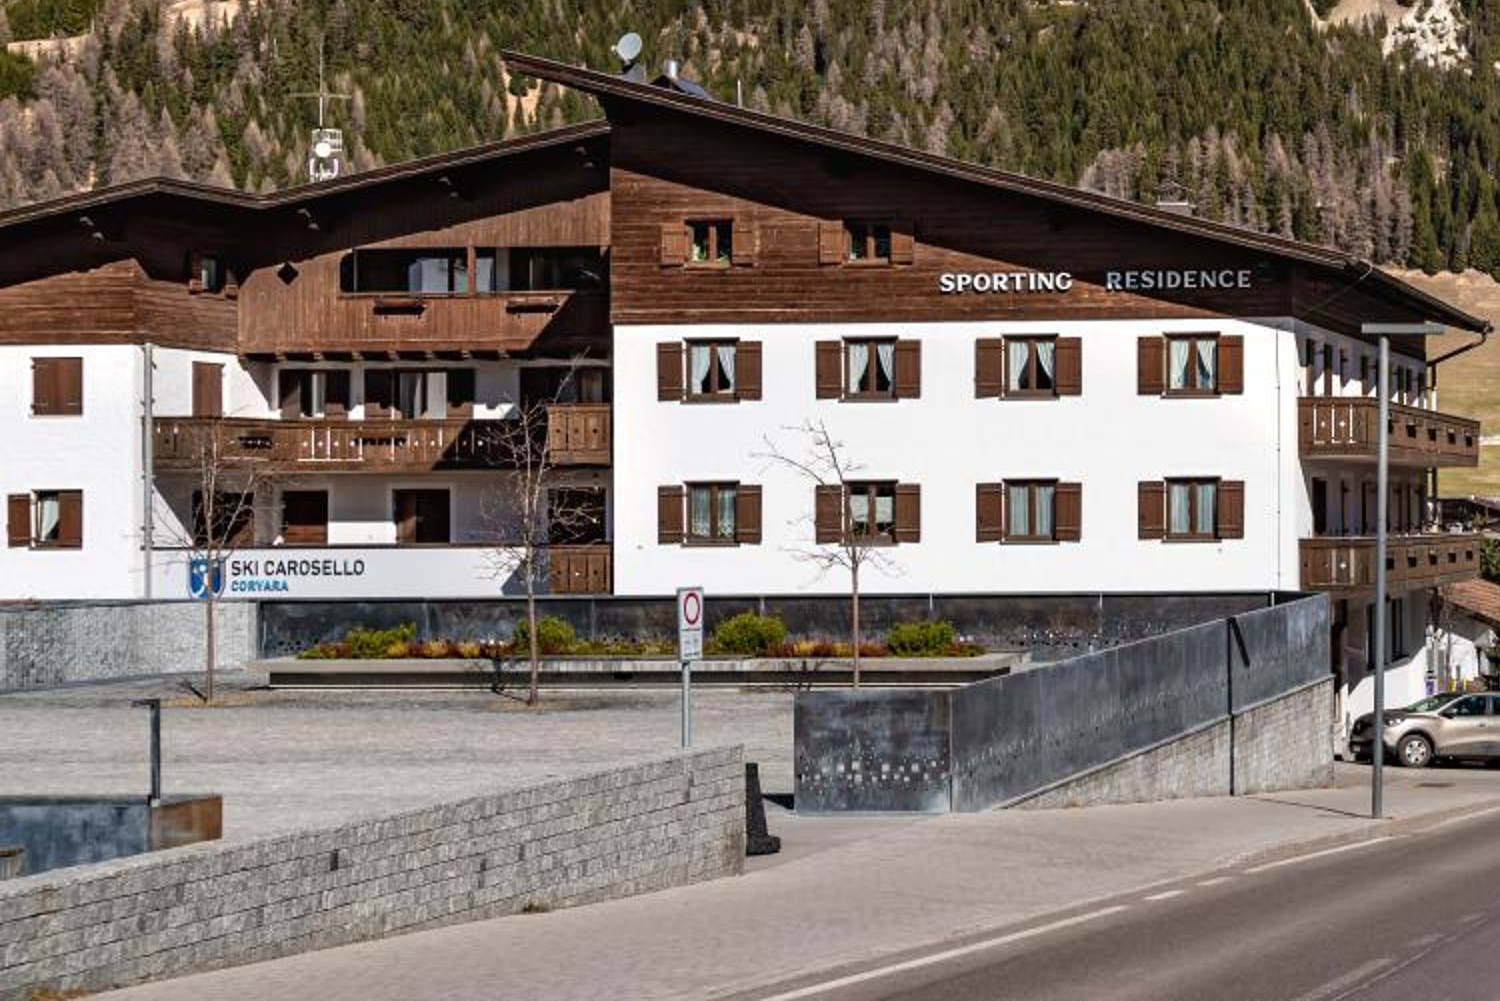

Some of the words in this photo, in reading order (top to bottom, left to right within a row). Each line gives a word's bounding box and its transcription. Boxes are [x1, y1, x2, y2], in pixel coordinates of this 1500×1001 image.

[939, 273, 1073, 292] SPORTING
[1107, 270, 1251, 289] RESIDENCE
[231, 560, 259, 576] SKI
[264, 560, 365, 576] CAROSELLO
[231, 580, 289, 592] CORVARA
